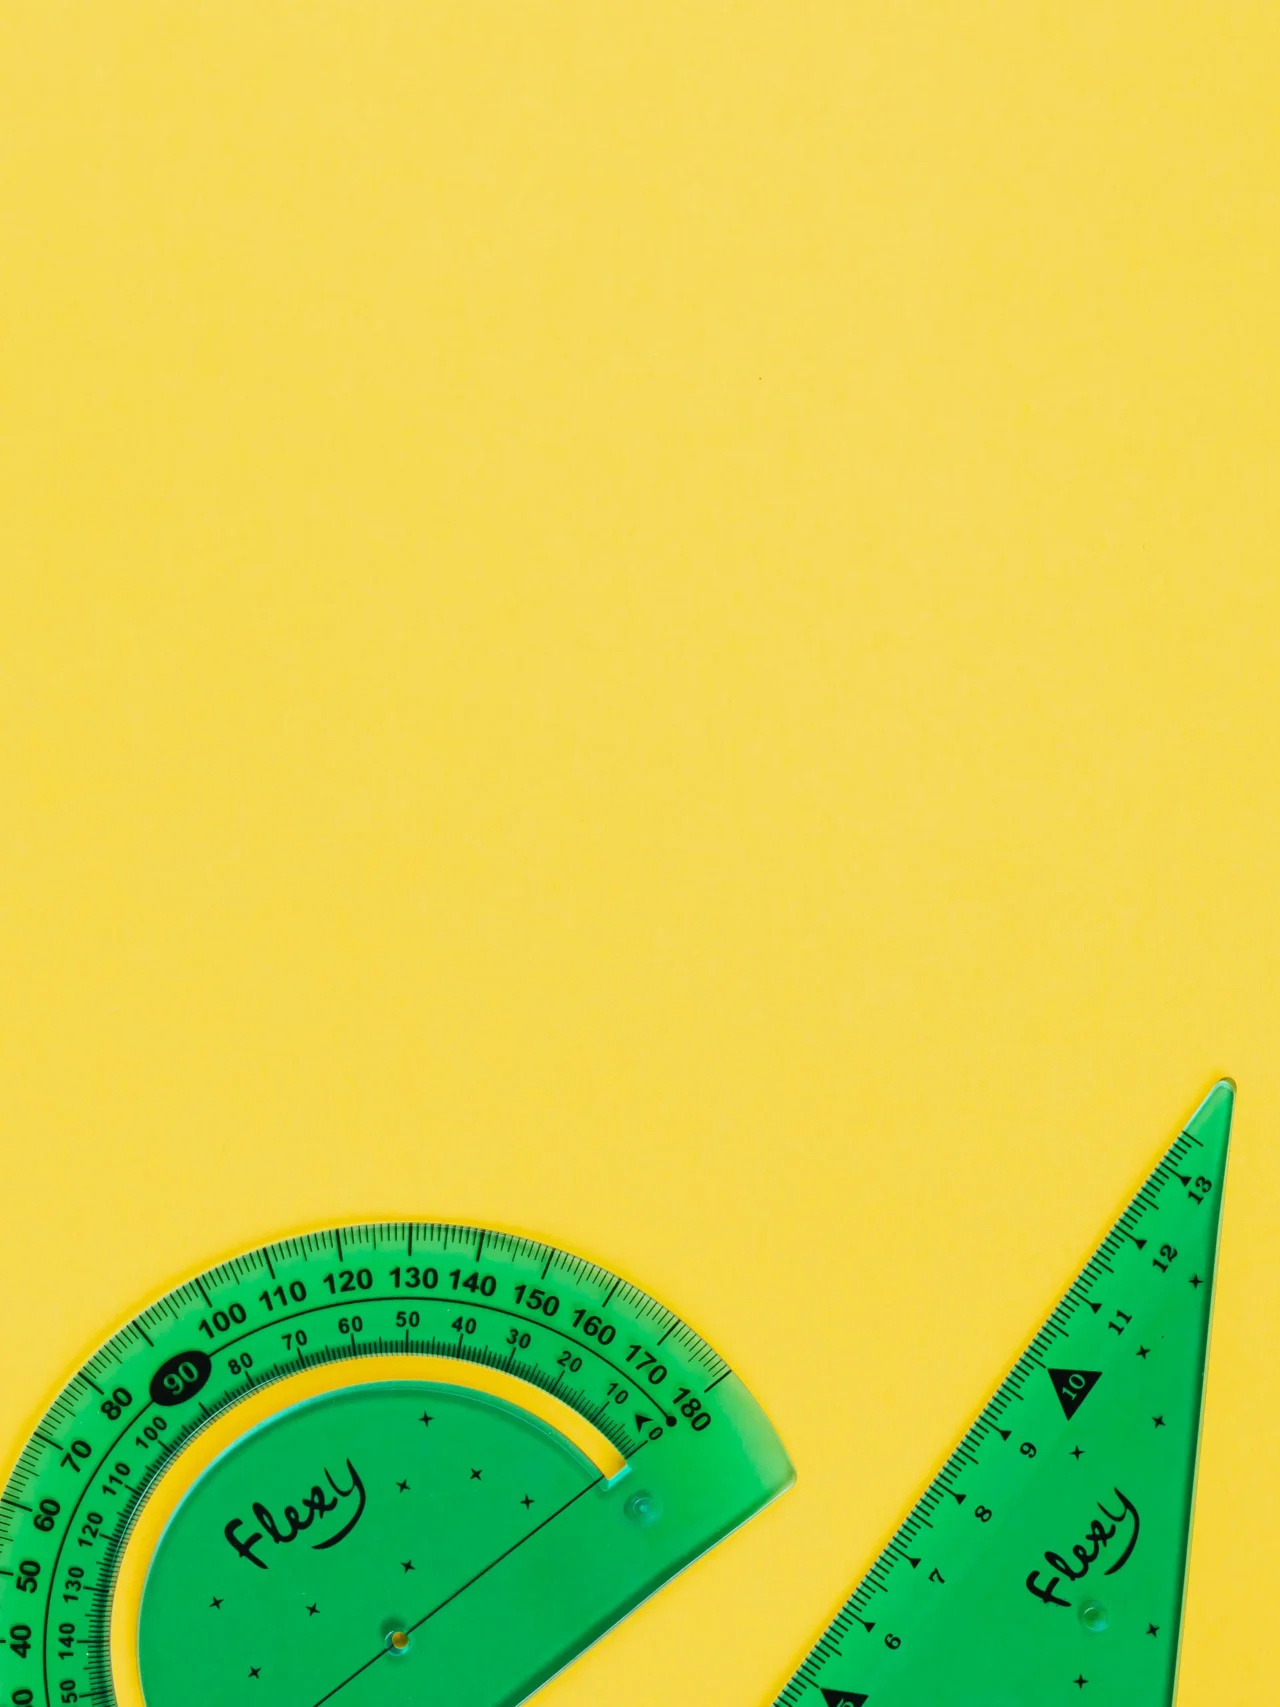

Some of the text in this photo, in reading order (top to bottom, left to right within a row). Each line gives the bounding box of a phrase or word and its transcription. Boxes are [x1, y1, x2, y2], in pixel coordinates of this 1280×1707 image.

[9, 1266, 712, 1707] 0 40 50 60 70 80 90 100 110 120 130 140 150 160 170 180
[57, 1311, 664, 1704] 50 140 130 120 110 100 80 70 60 50 40 30 20 10 0
[223, 1458, 367, 1570] Flexy
[884, 1633, 902, 1650] 6
[928, 1567, 945, 1584] 7
[974, 1505, 993, 1523] 8
[1019, 1441, 1037, 1459] 9
[1062, 1373, 1086, 1400] 10
[1108, 1310, 1133, 1336] 11
[1152, 1244, 1178, 1273] 12
[1188, 1175, 1213, 1205] 13
[1025, 1487, 1141, 1607] Flexy
